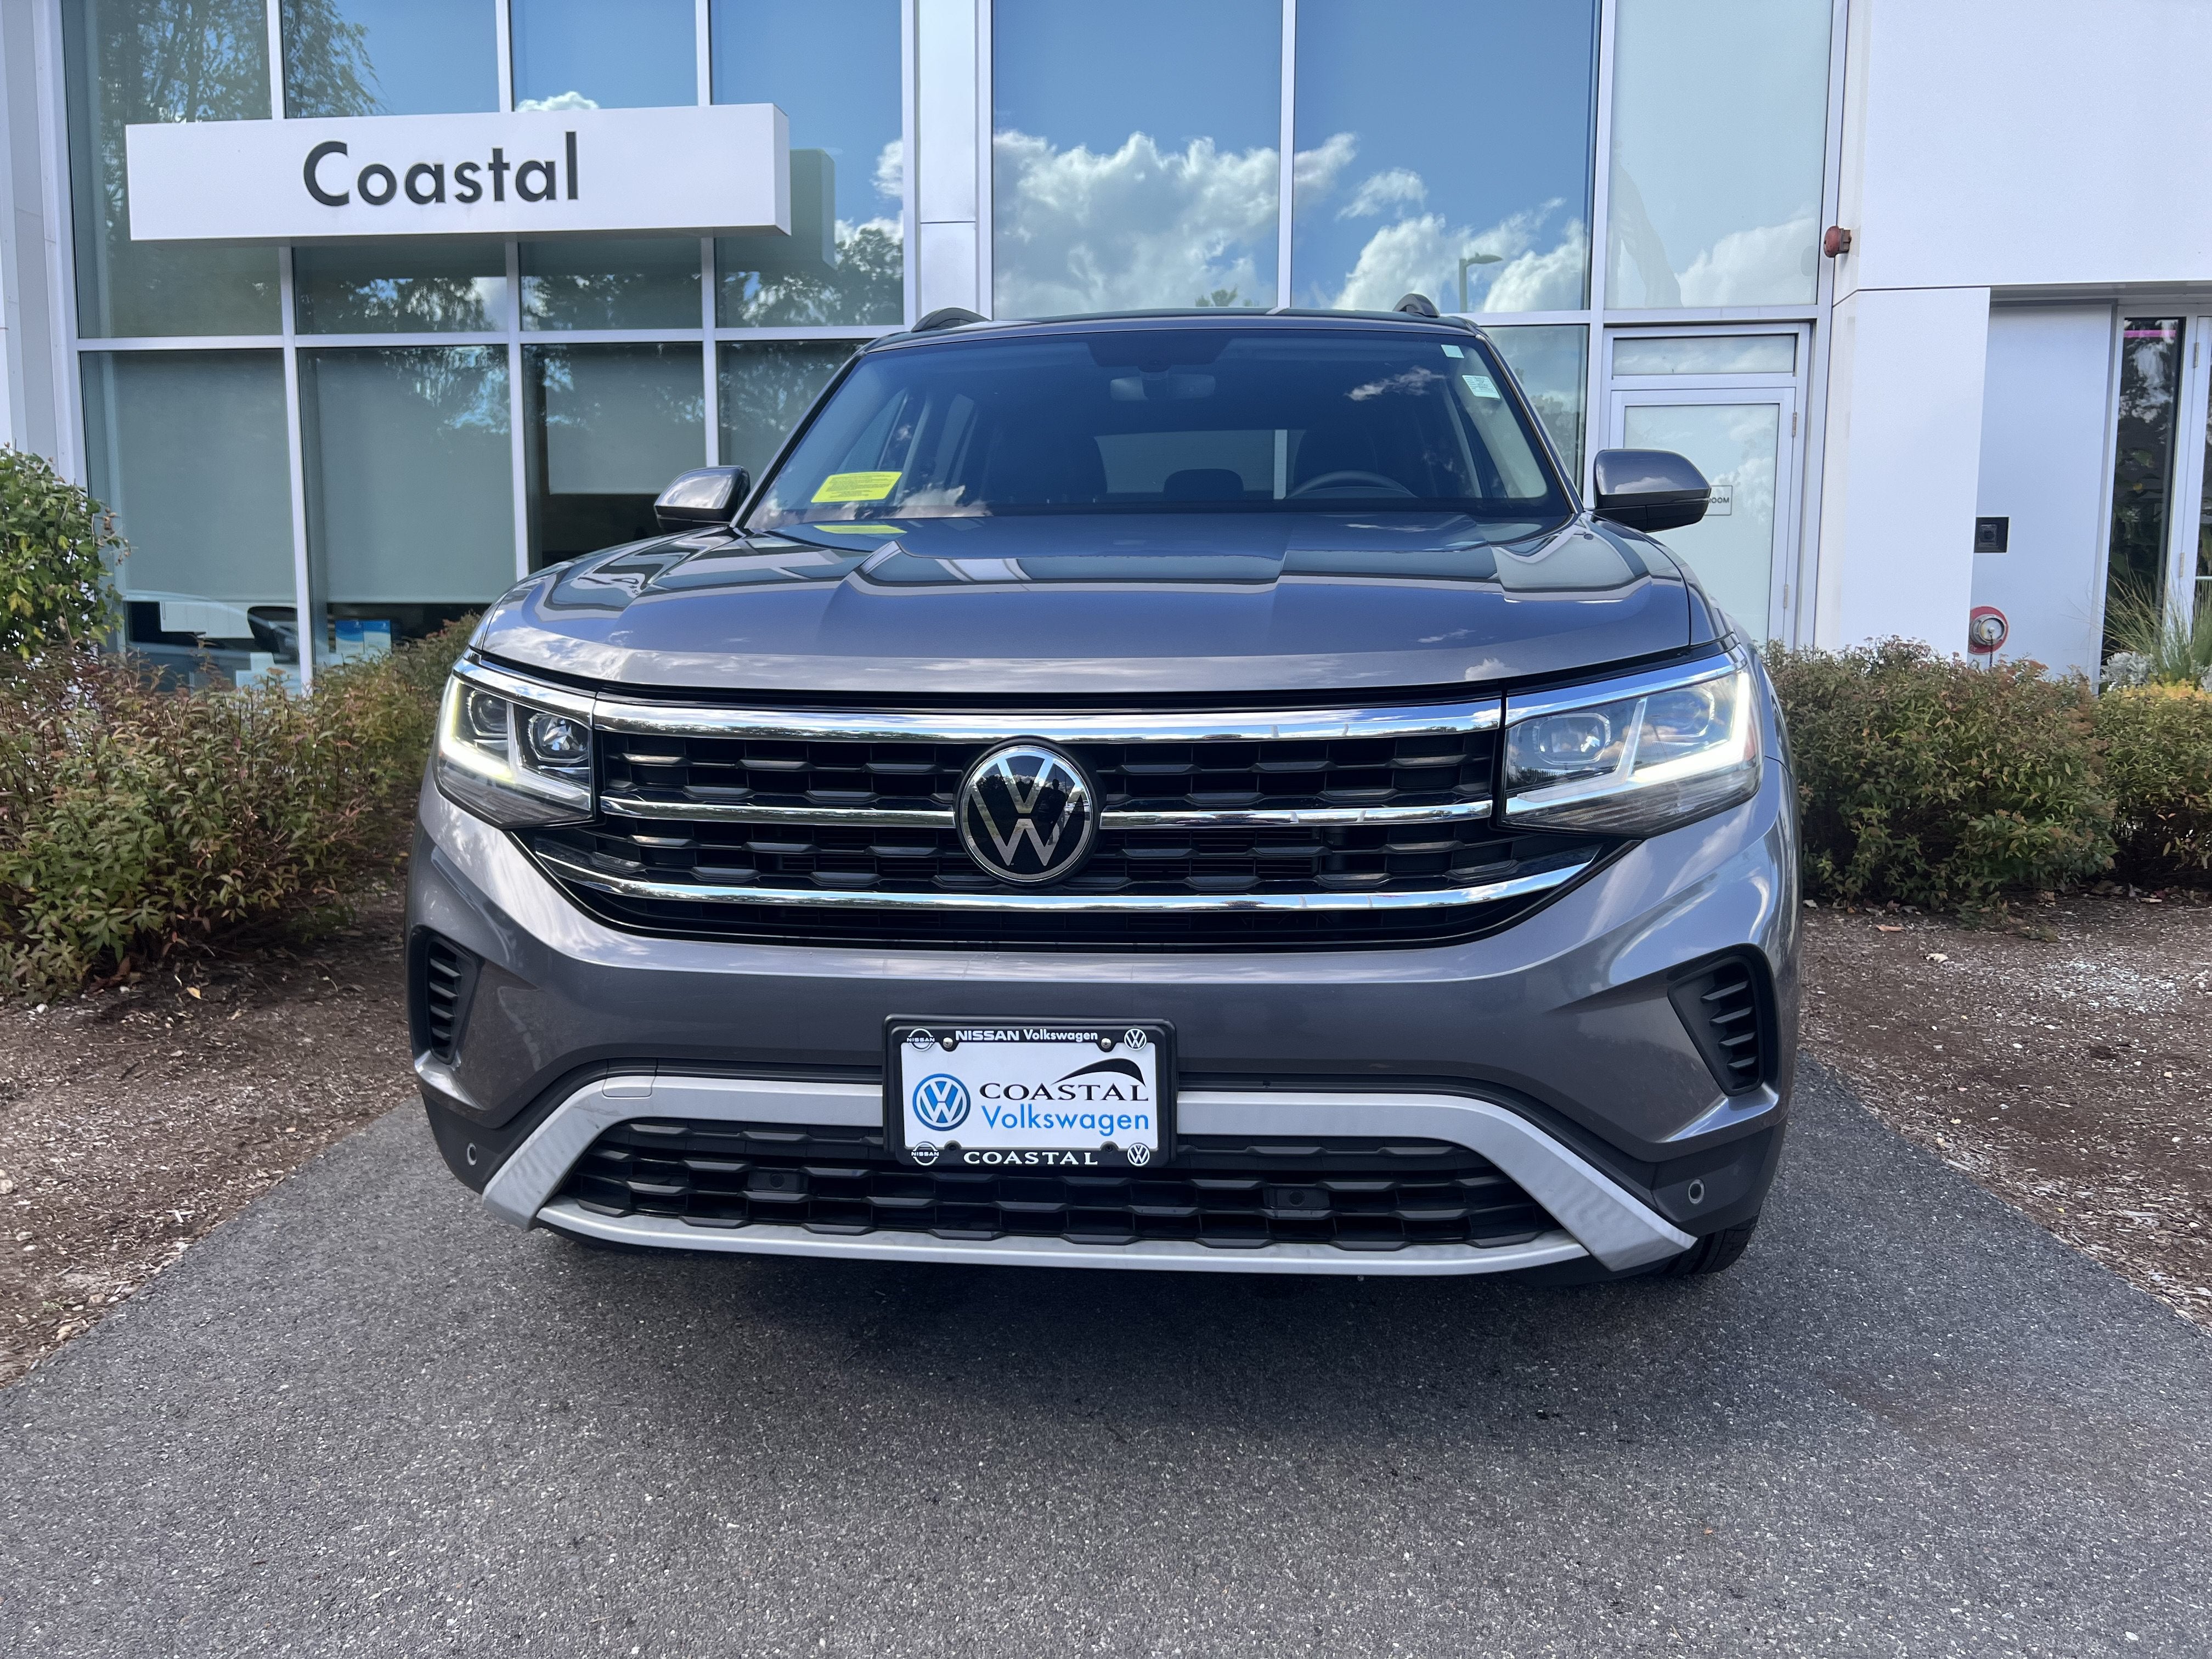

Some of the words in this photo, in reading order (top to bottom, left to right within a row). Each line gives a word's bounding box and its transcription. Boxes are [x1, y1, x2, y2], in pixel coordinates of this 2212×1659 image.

[303, 131, 578, 207] Coastal
[956, 1030, 1019, 1041] NISSAN
[1023, 1029, 1098, 1042] Volkswagen
[979, 1083, 1149, 1101] COASTAL
[981, 1104, 1149, 1137] Volkswagen
[964, 1151, 1098, 1165] COASTAL
